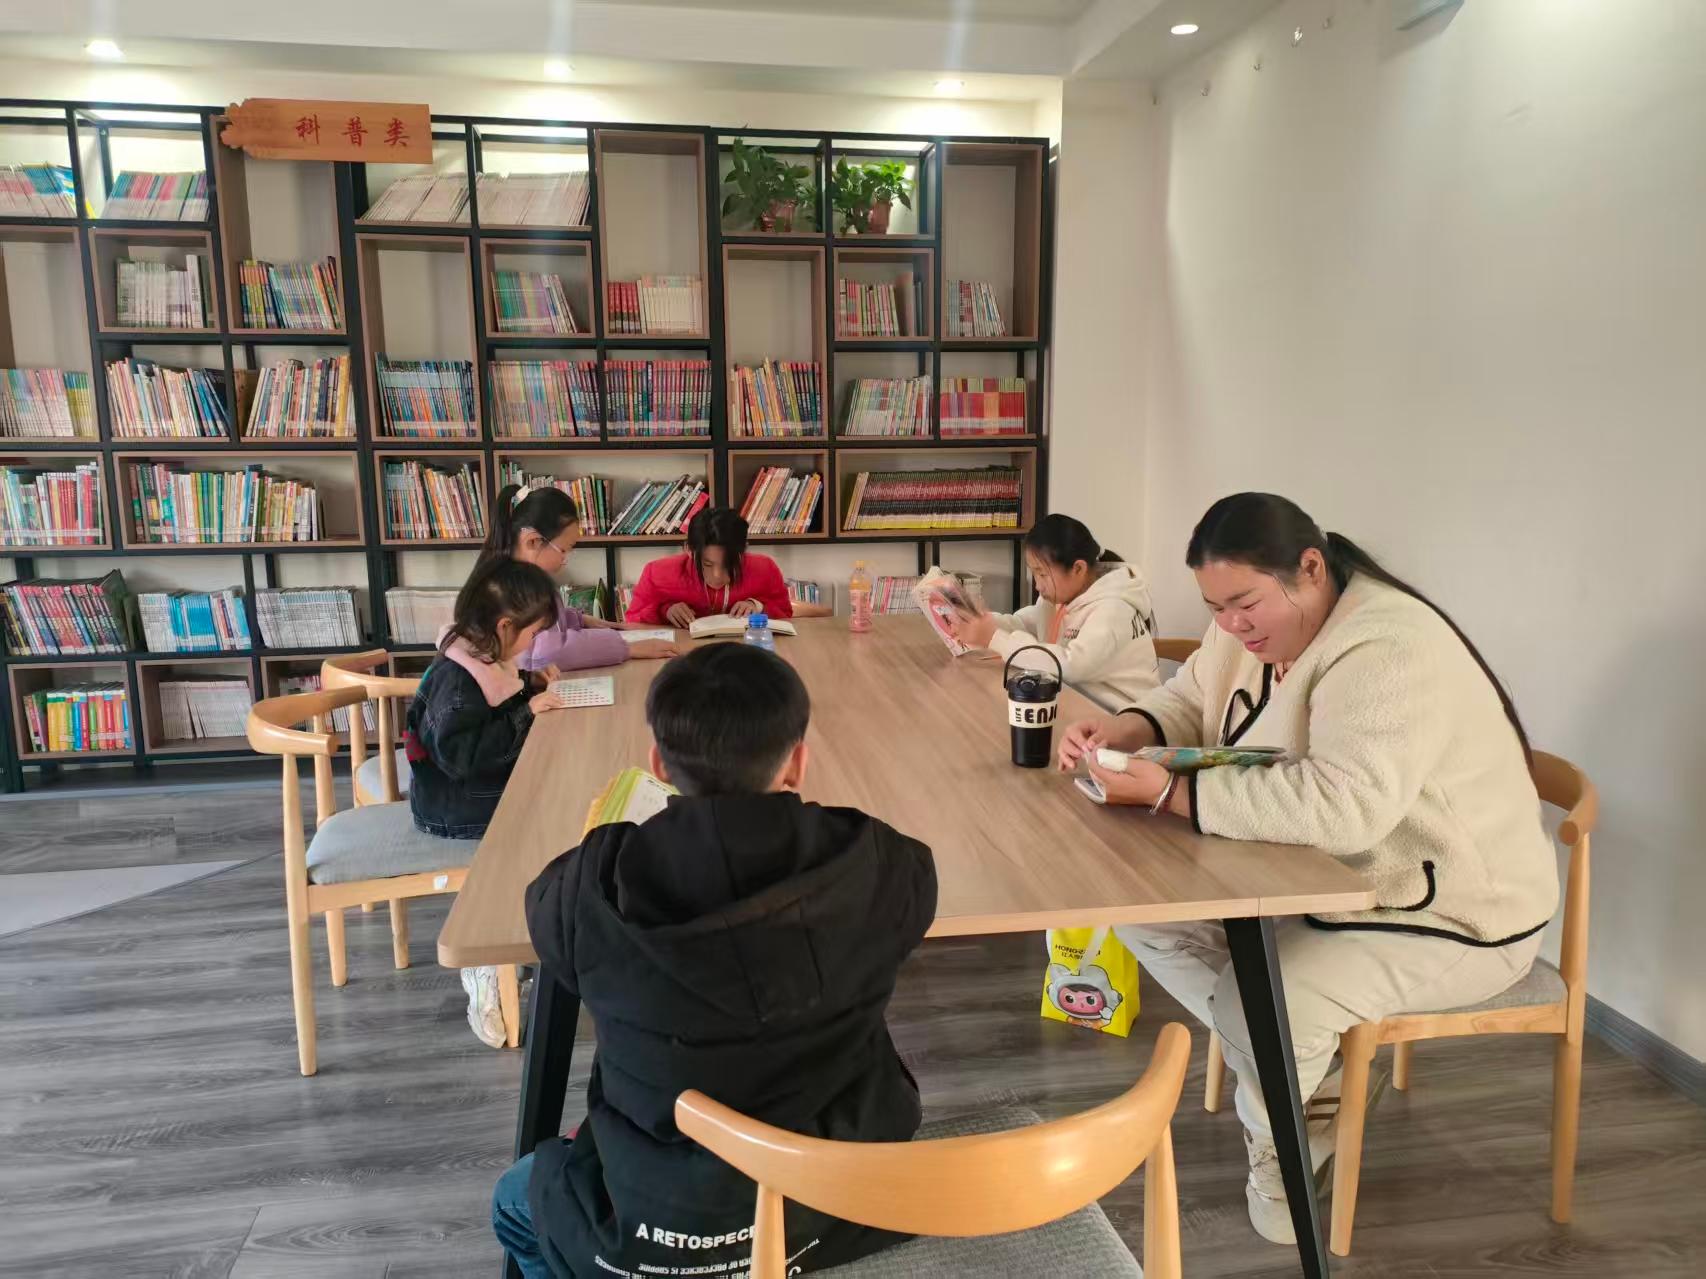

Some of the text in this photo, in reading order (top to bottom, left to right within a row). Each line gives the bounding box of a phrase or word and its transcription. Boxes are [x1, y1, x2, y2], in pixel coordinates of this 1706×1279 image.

[295, 114, 410, 147] 科普类
[635, 1223, 650, 1240] A
